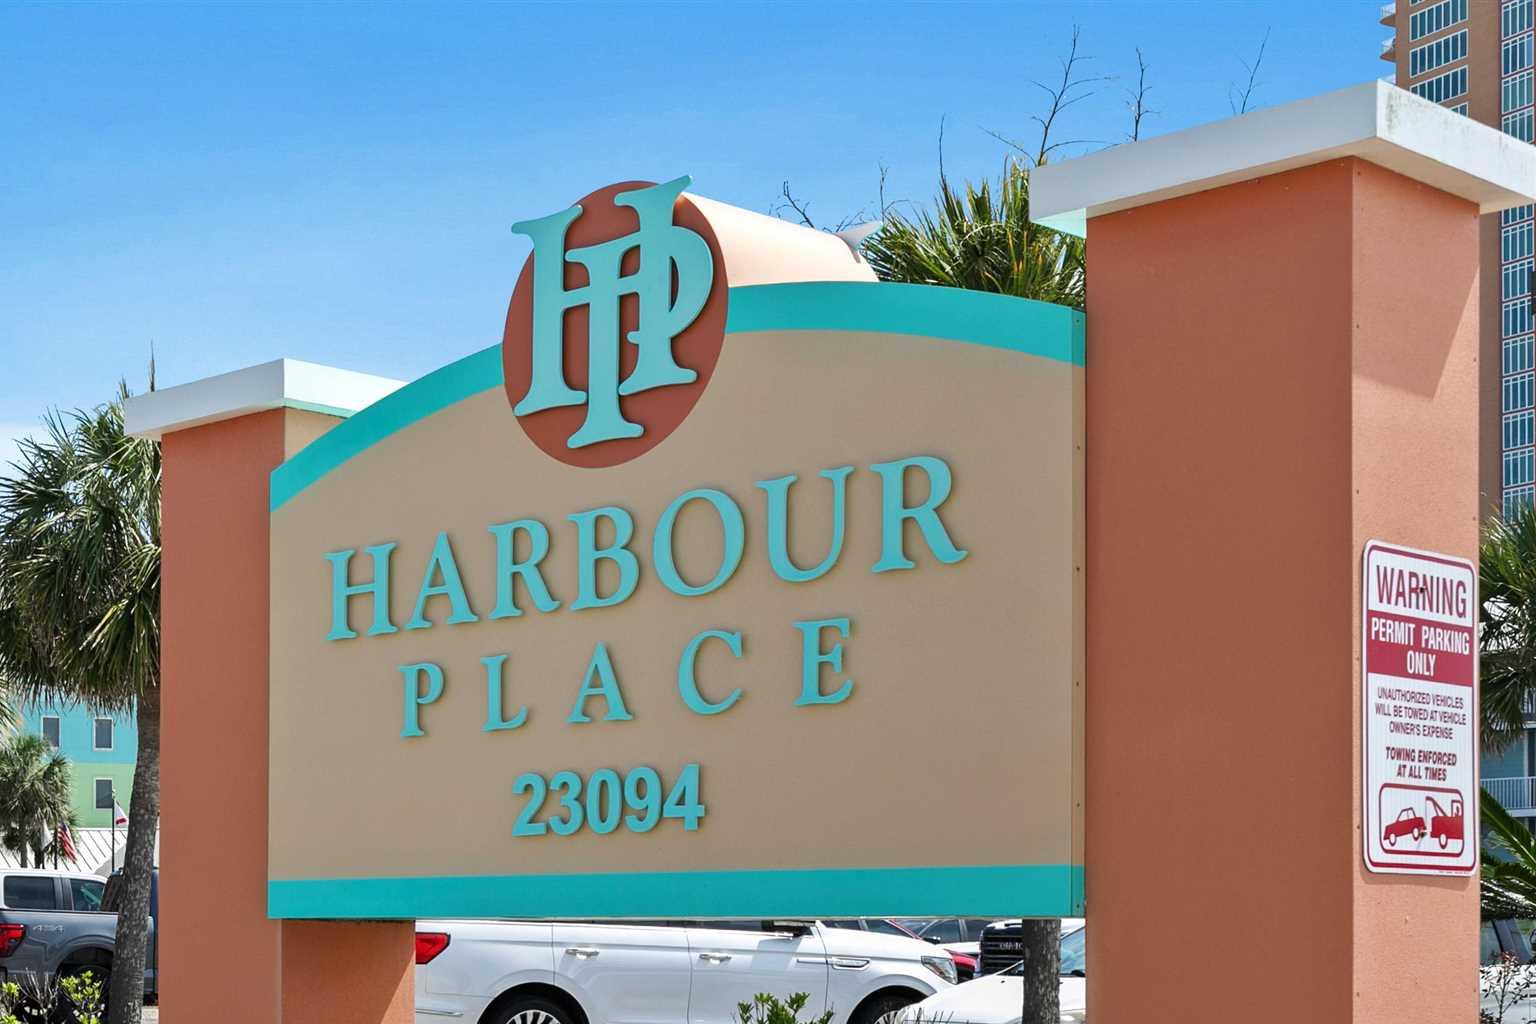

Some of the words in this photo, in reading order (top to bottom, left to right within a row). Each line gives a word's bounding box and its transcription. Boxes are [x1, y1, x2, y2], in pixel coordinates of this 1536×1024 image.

[323, 455, 968, 642] HARBOUR
[1376, 565, 1466, 618] WARNING
[1371, 617, 1415, 646] PERMIT
[1421, 625, 1469, 655] PARKING
[1407, 650, 1436, 676] ONLY
[398, 617, 854, 739] PLACE
[1377, 687, 1431, 705] UNAUTHORIZED
[1432, 694, 1464, 710] VEHICLES
[1375, 702, 1392, 717] WILL
[1393, 705, 1403, 718] BE
[1404, 706, 1429, 721] TOWED
[1429, 710, 1438, 722] AT
[1439, 711, 1467, 726] VEHICLE
[1389, 721, 1421, 736] OWNER'S
[1422, 724, 1453, 740] EXPENSE
[1386, 746, 1416, 762] TOWING
[1417, 750, 1457, 766] ENFORCED
[1396, 764, 1407, 778] AT
[1408, 765, 1422, 779] ALL
[1424, 766, 1447, 781] TIMES
[511, 762, 705, 837] 23094
